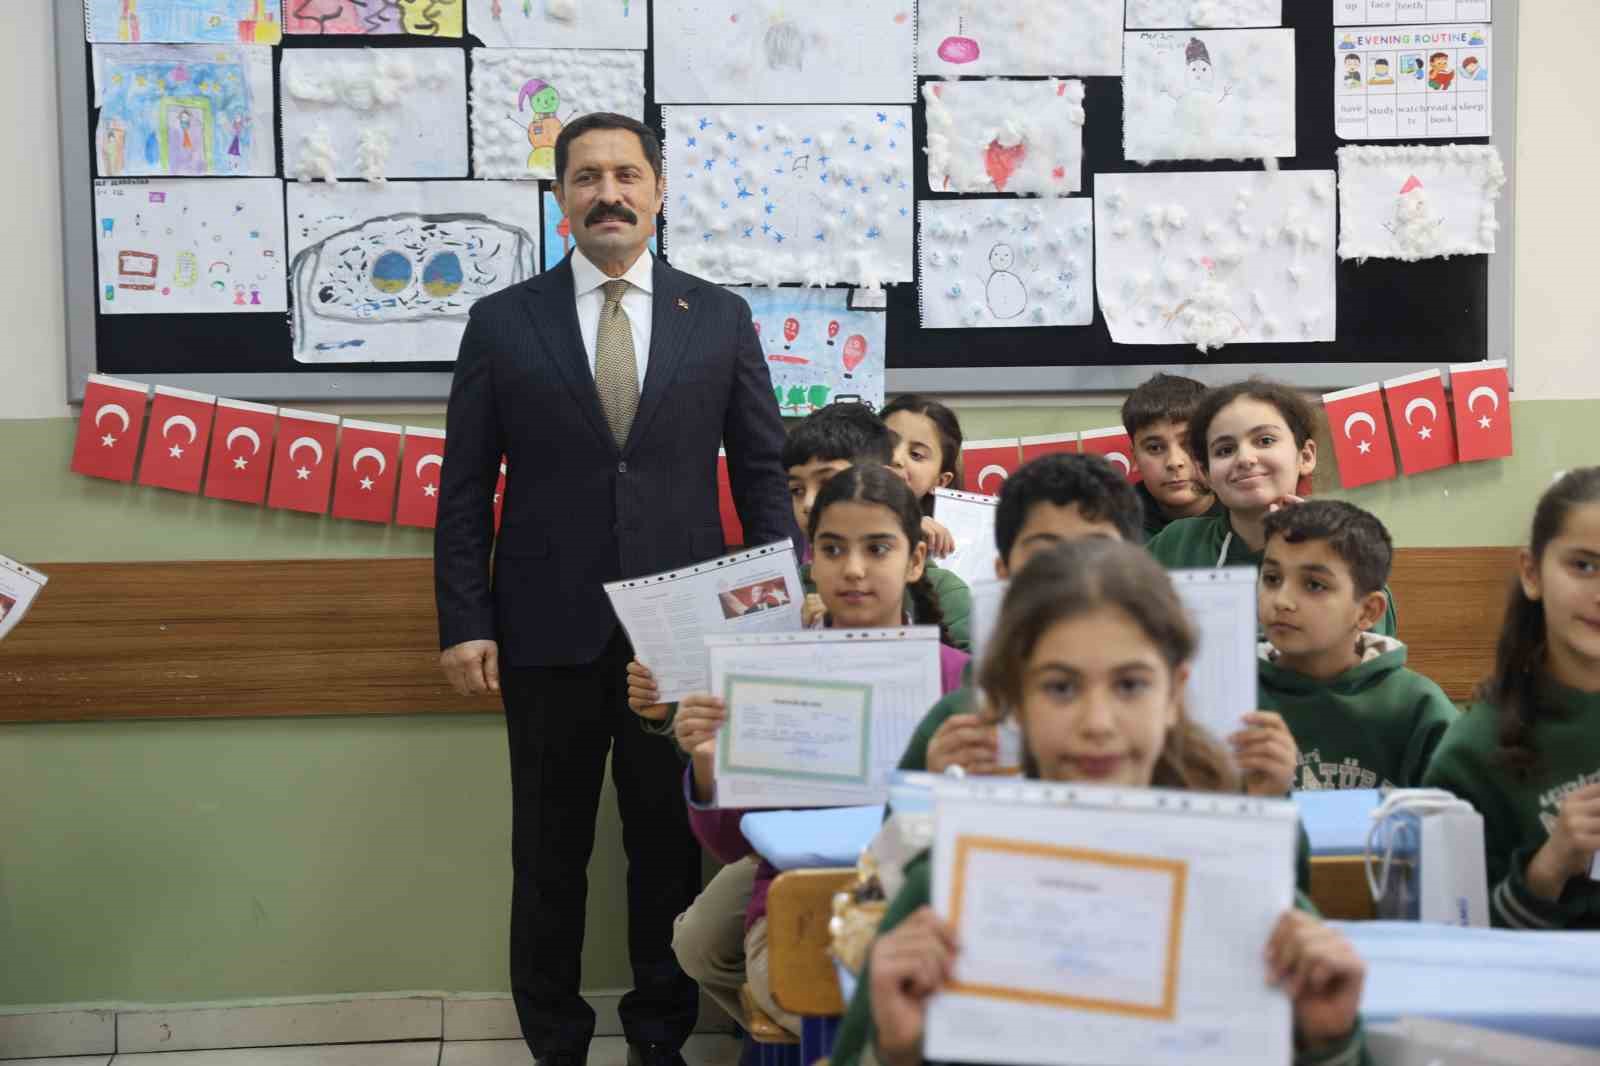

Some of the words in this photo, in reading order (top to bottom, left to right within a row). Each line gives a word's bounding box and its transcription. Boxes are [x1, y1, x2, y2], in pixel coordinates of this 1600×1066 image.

[1344, 2, 1358, 10] up
[1369, 0, 1391, 8] face
[1357, 34, 1410, 46] EVENING
[1414, 32, 1467, 43] ROUTINE
